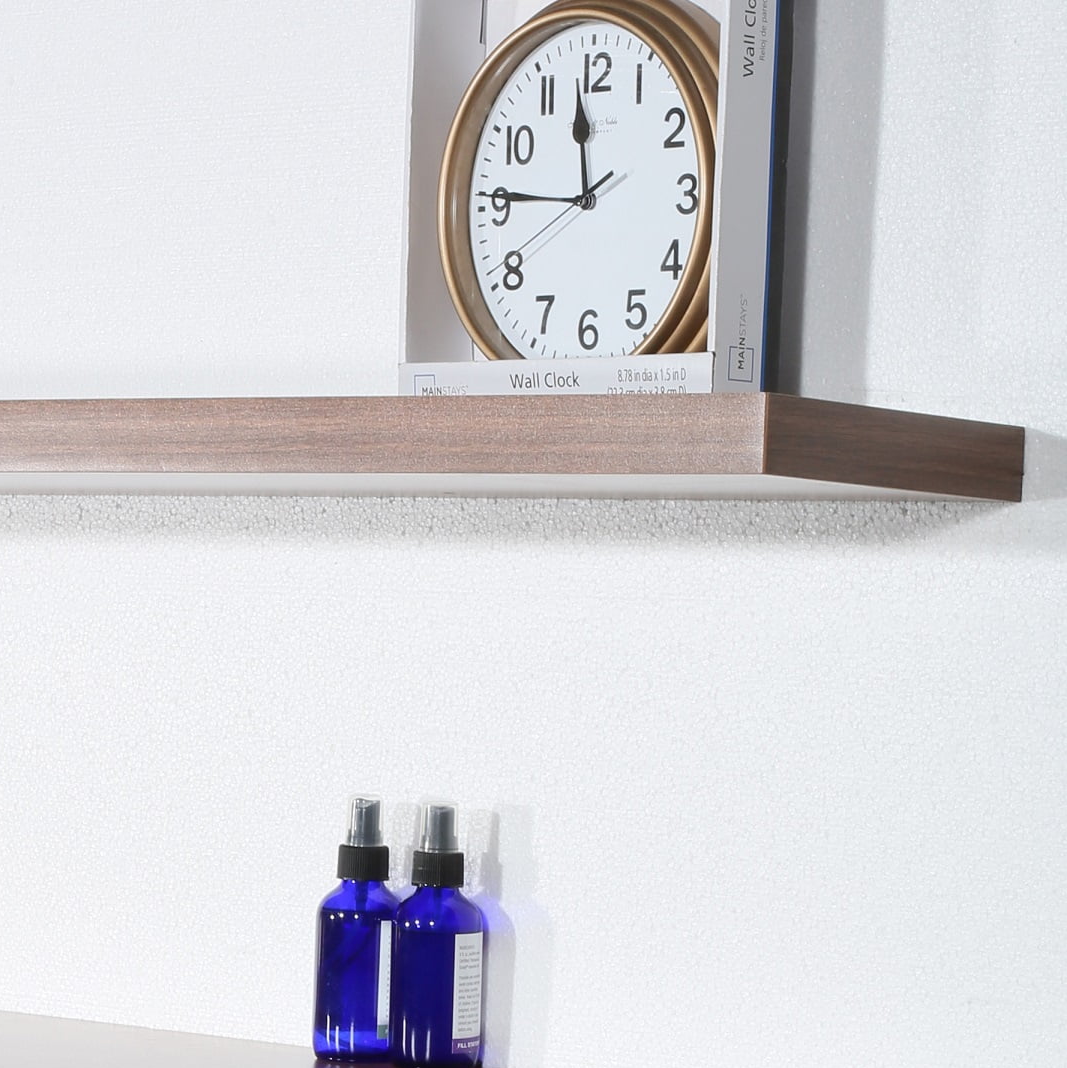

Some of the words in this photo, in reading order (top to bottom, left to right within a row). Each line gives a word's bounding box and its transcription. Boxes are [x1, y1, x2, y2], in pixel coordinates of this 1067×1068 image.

[760, 25, 767, 37] de
[583, 52, 612, 93] 12
[743, 34, 755, 77] Wall
[540, 74, 555, 116] 11
[635, 63, 643, 105] 1
[506, 124, 534, 165] 10
[663, 107, 686, 149] 2
[491, 186, 511, 227] 9
[675, 173, 699, 215] 3
[502, 250, 524, 291] 8
[660, 239, 683, 280] 4
[535, 295, 555, 335] 7
[578, 309, 599, 350] 6
[625, 289, 648, 330] 5
[509, 372, 539, 389] Wall
[545, 371, 580, 389] Clock
[617, 369, 633, 382] 8.78
[634, 369, 641, 382] in
[642, 368, 653, 382] dia
[653, 371, 659, 382] x
[660, 368, 671, 381] 1.5
[672, 368, 679, 381] in
[680, 367, 687, 381] D
